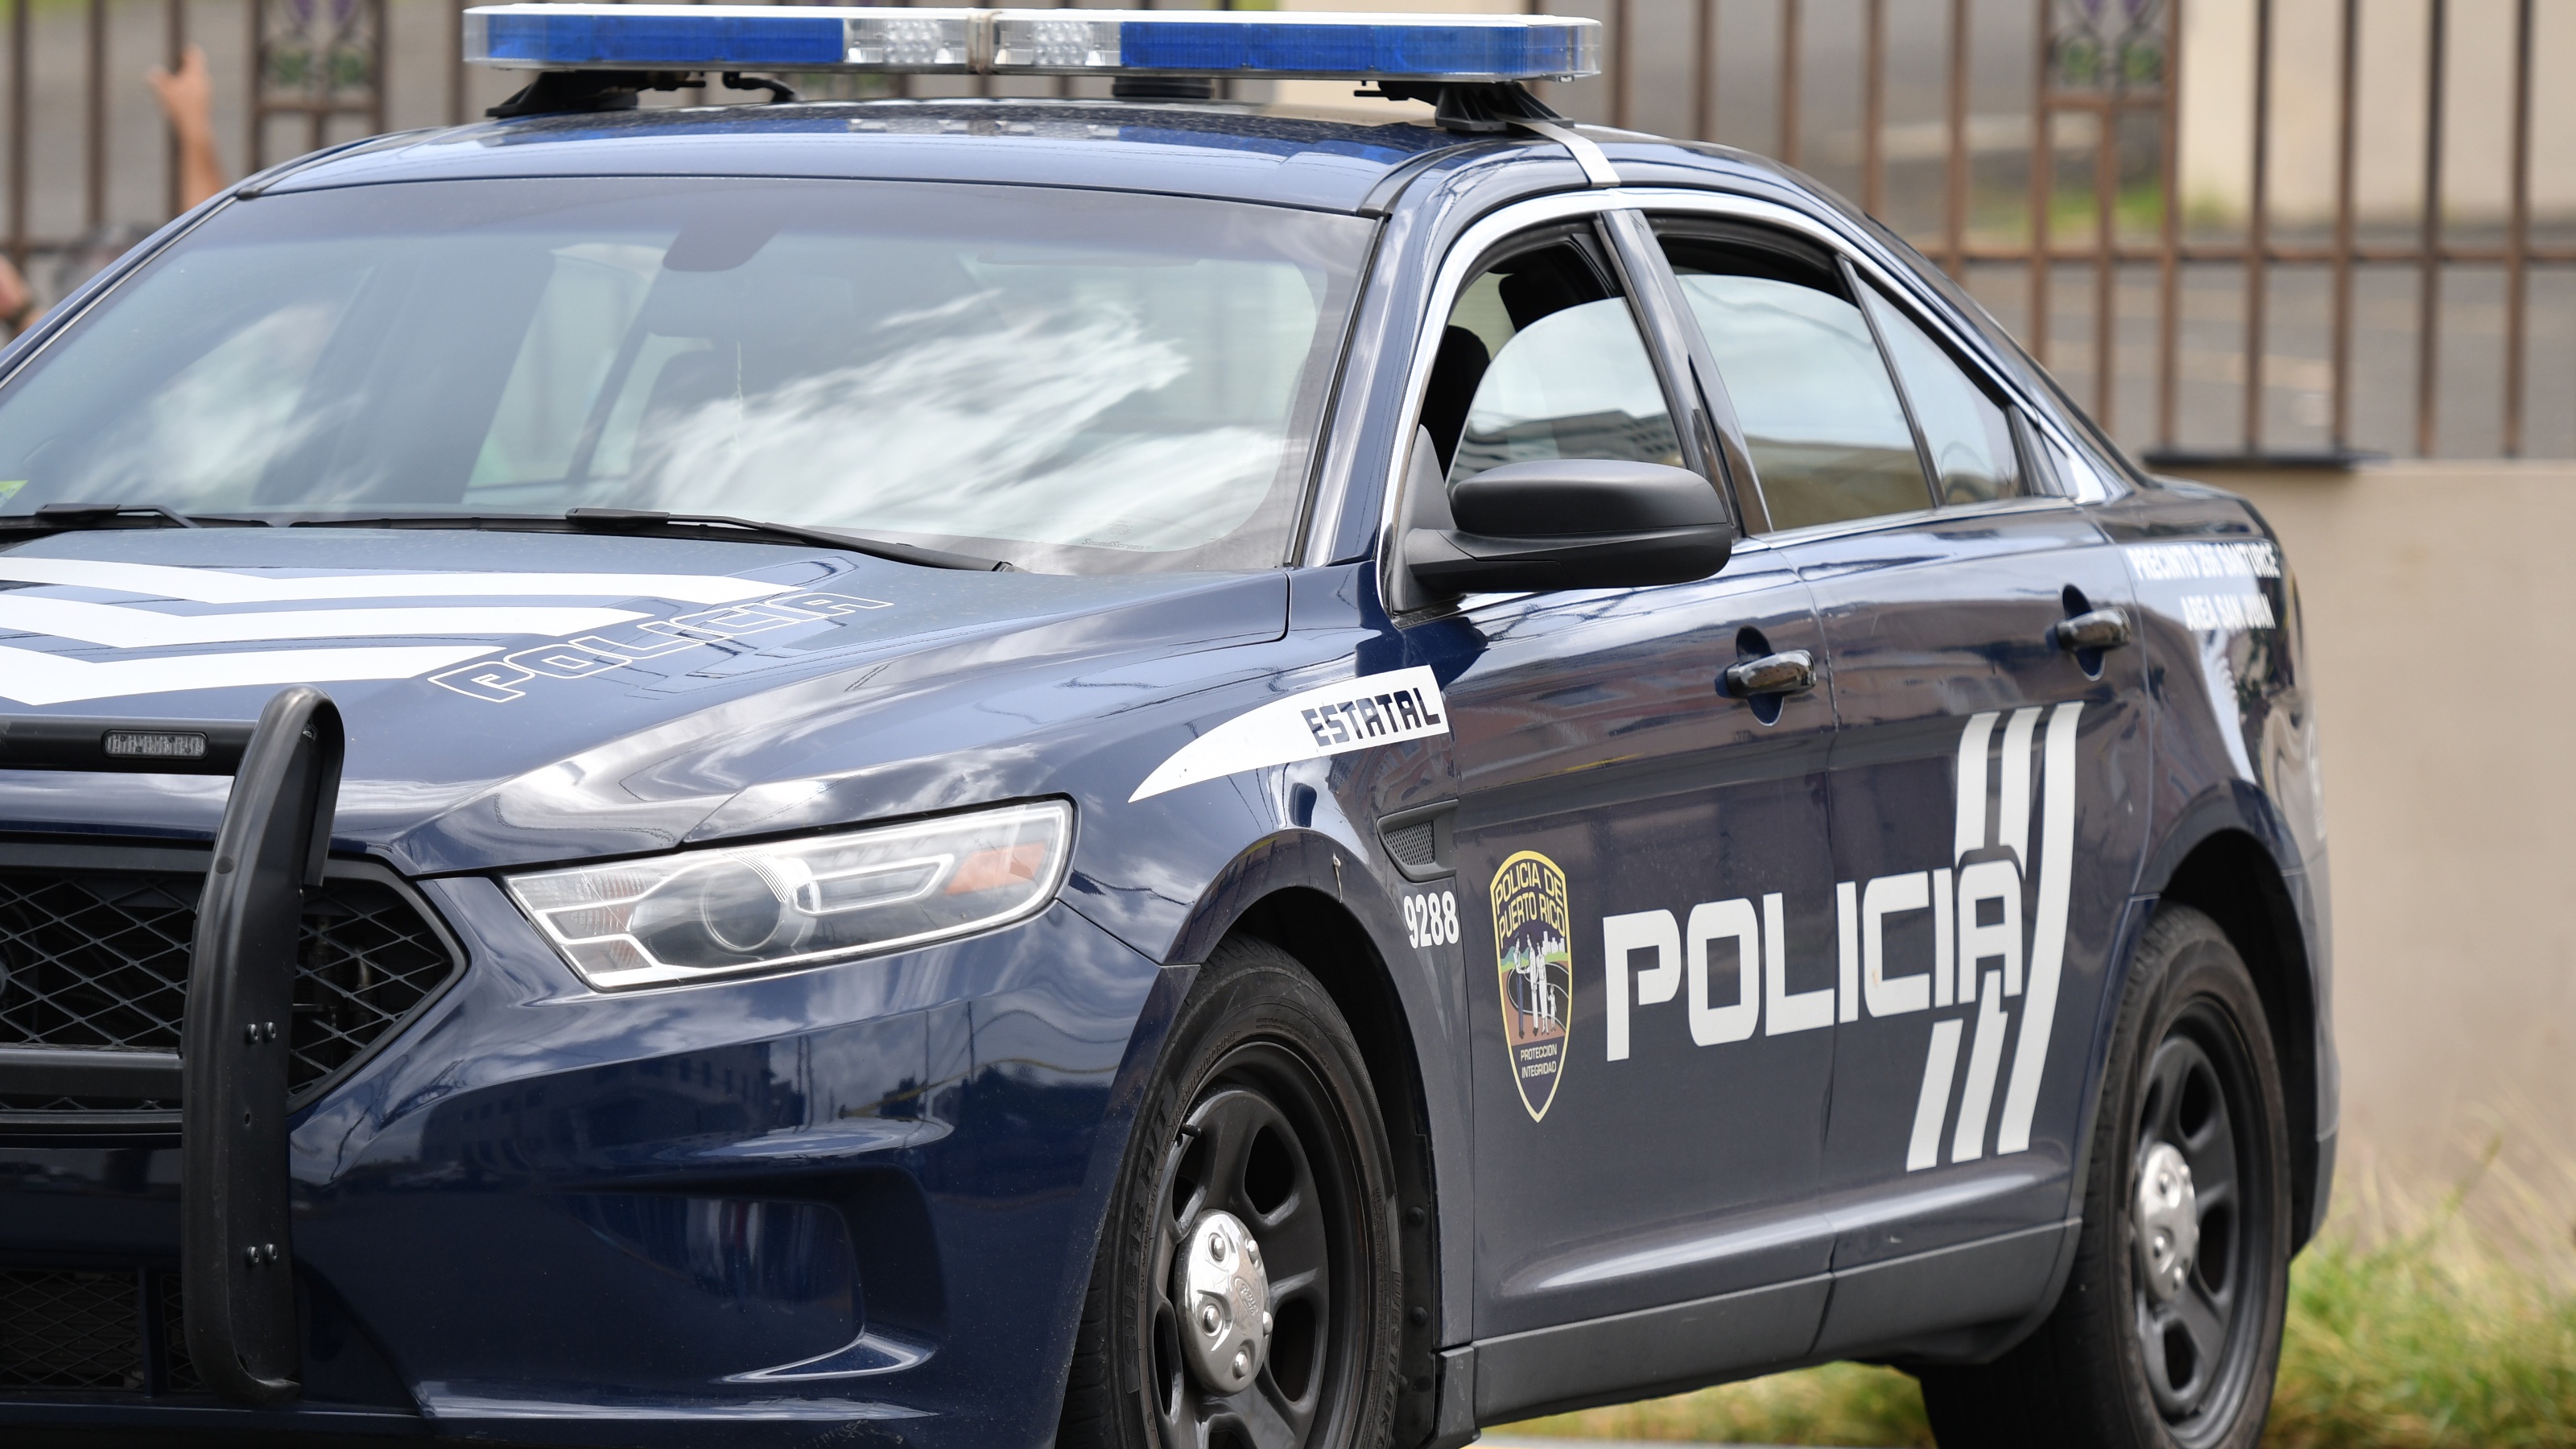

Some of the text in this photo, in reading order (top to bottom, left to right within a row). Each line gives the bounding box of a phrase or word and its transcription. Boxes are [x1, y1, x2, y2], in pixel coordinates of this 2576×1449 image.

[1082, 539, 1145, 551] SoundScreen
[2125, 545, 2200, 580] PRECINTO
[2215, 543, 2281, 578] SANTURCE
[2181, 592, 2277, 631] AREA SAN JUAN
[427, 592, 895, 704] POLICIA
[1301, 687, 1441, 747] ESTATAL
[1496, 862, 1564, 916] POLICIA DE
[1403, 890, 1459, 950] 9288
[1499, 891, 1566, 950] PUERTO RICO
[1603, 859, 2024, 1062] POLICIA
[1521, 1043, 1558, 1062] PROTECCION
[1521, 1060, 1557, 1079] INTEGRIDAD
[1124, 1201, 1144, 1366] SU318
[1139, 1099, 1166, 1189] H/T
